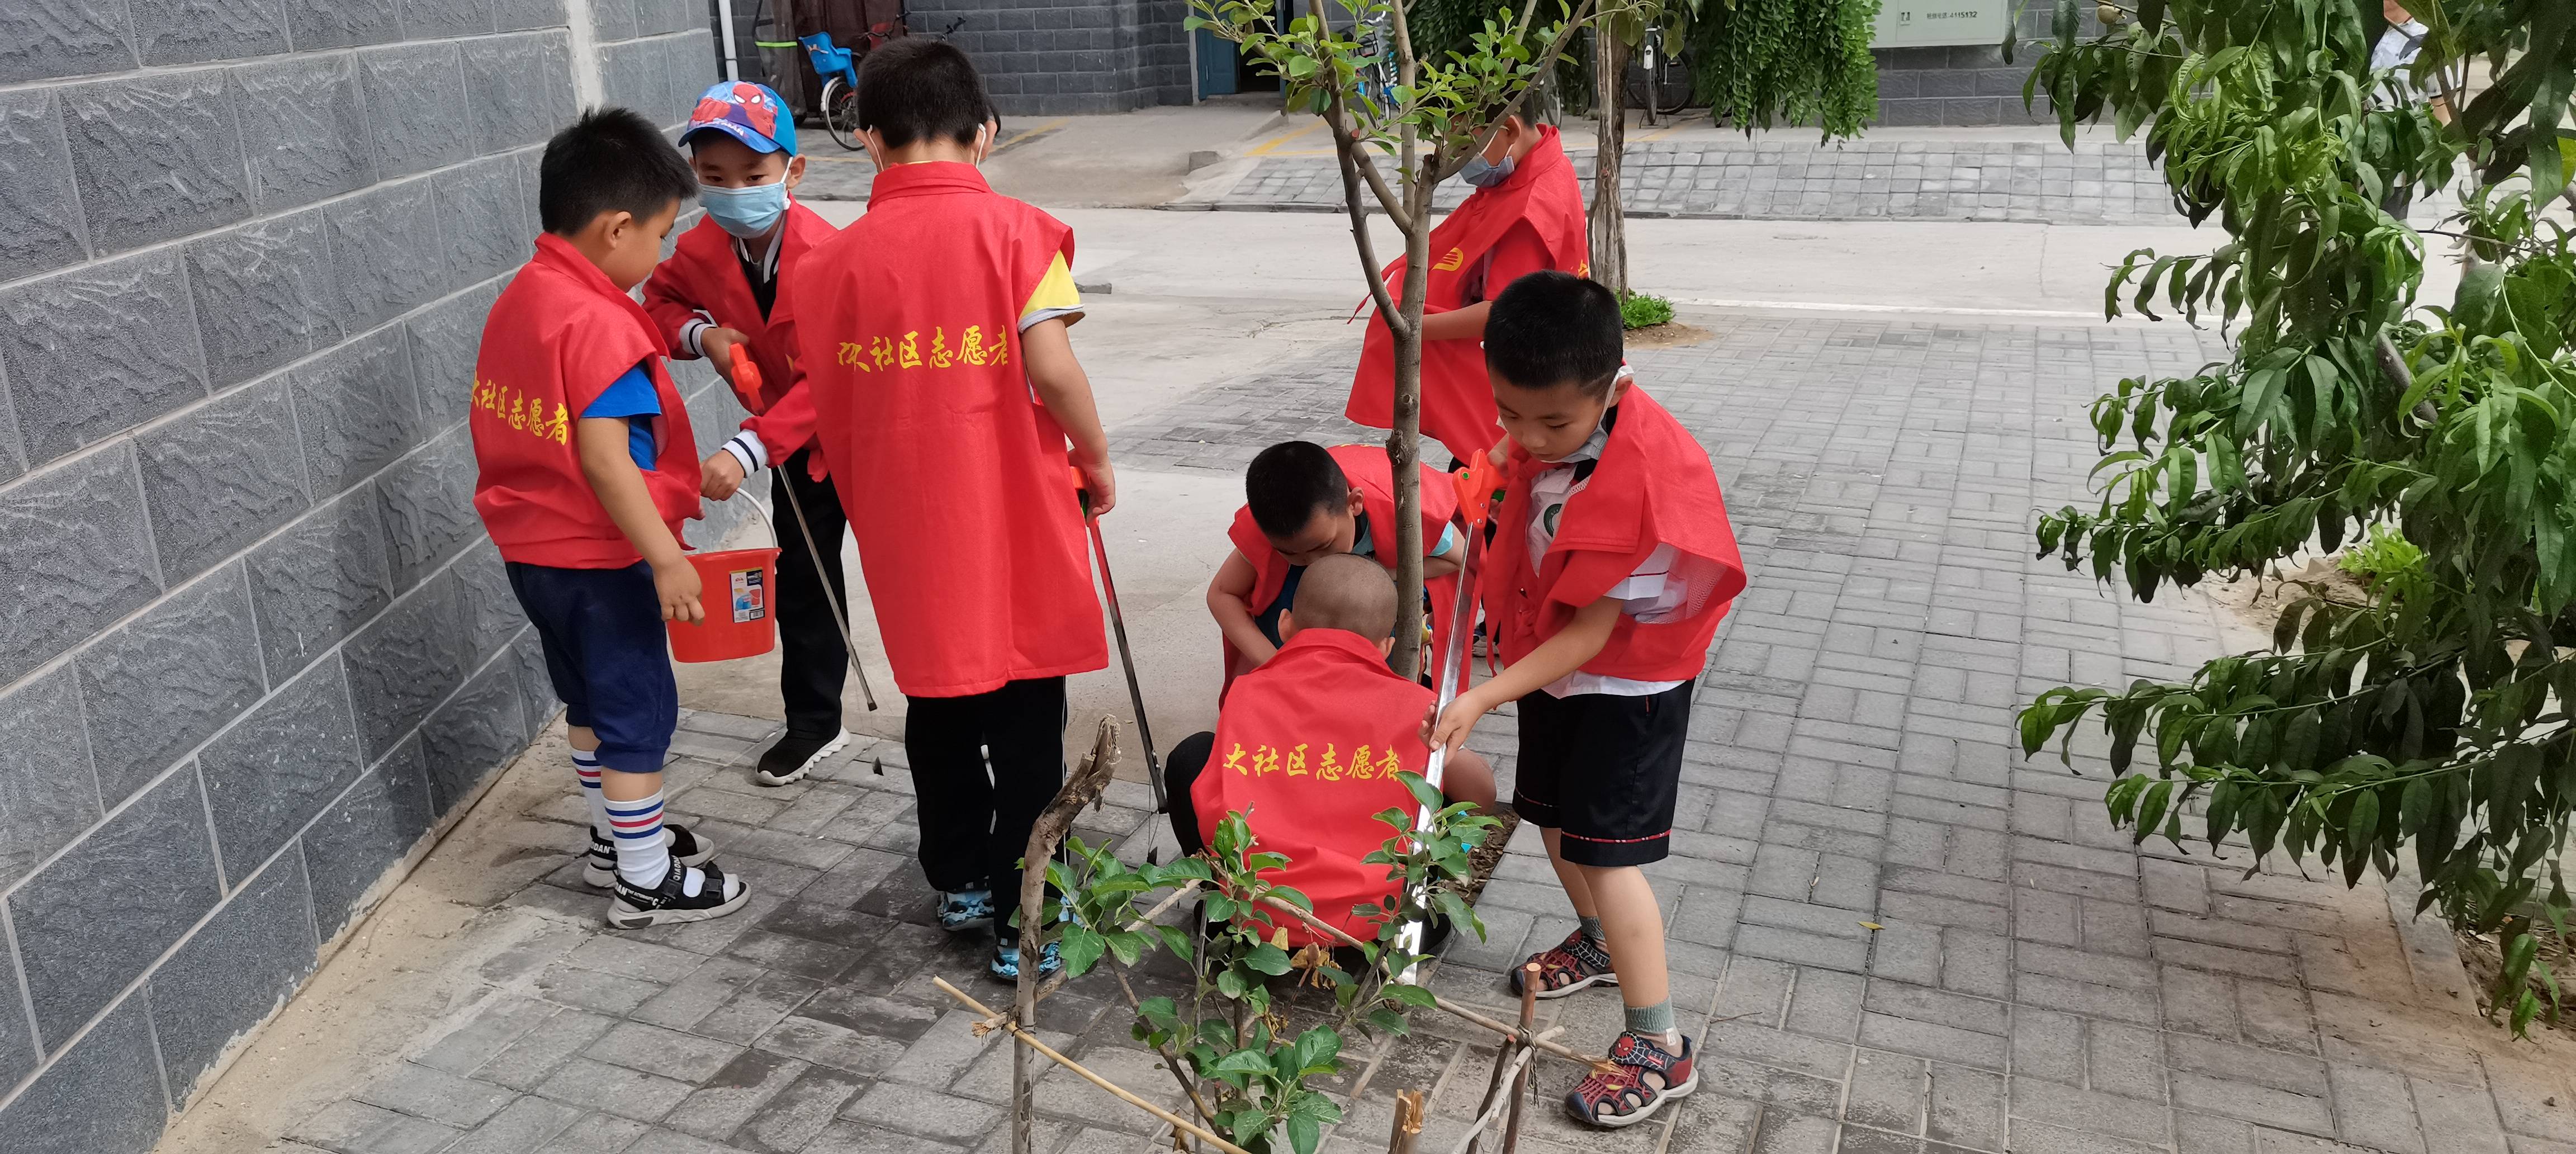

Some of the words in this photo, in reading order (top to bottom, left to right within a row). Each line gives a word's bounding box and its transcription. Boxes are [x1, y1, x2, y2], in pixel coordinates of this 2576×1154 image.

[1223, 742, 1401, 782] 大社区志愿者
